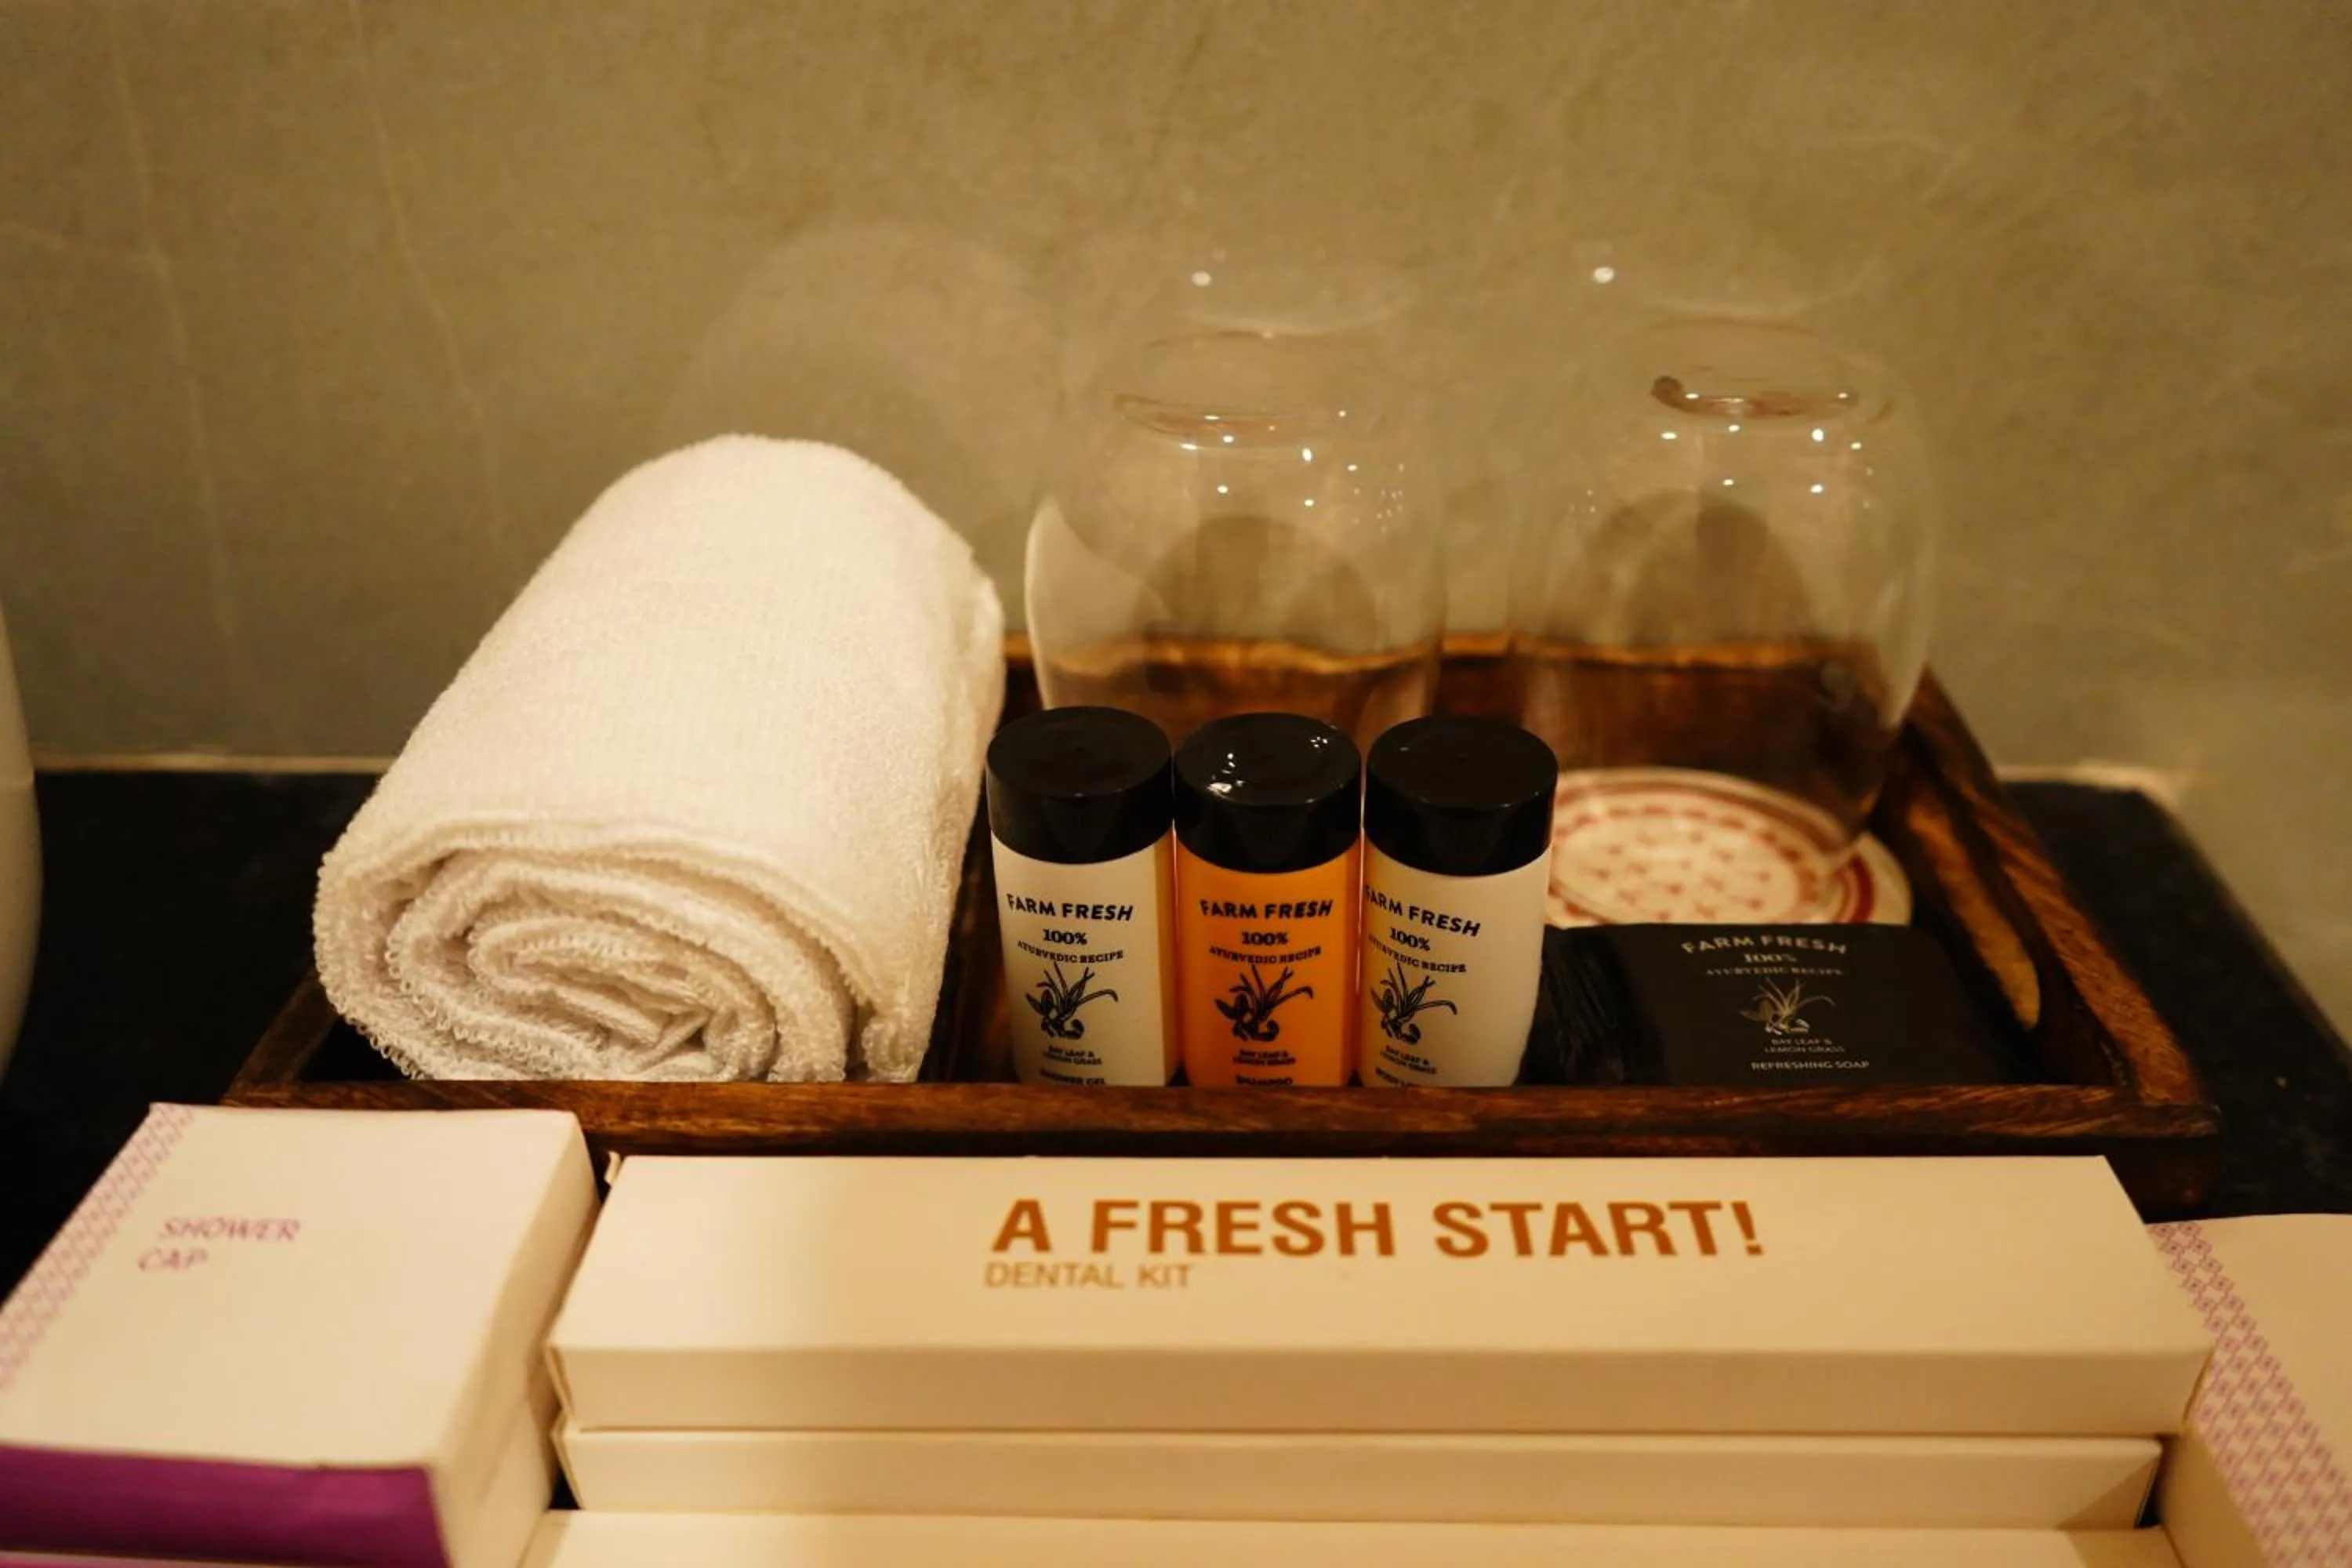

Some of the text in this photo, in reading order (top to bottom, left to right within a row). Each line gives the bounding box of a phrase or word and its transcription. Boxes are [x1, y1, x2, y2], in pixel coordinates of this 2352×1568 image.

[1006, 894, 1134, 921] FARM FRESH
[1200, 899, 1334, 919] FARM FRESH
[1364, 884, 1481, 937] FARM FRESH
[1043, 928, 1088, 946] 100%
[1241, 931, 1289, 946] 100%
[1389, 926, 1431, 952] 100%
[1681, 935, 1847, 954] FARM FRESH
[1017, 940, 1123, 964] AYURVEDIC RECIPE
[1209, 945, 1322, 964] AYURVEDIC RECIPE
[1421, 961, 1468, 974] RECIPE
[1751, 1061, 1870, 1070] REFRESHING SOAP
[158, 1217, 301, 1241] SHOWER
[992, 1199, 1764, 1257] A FRESH START!
[137, 1247, 209, 1271] CAP
[985, 1261, 1191, 1288] DENTAL KIT
